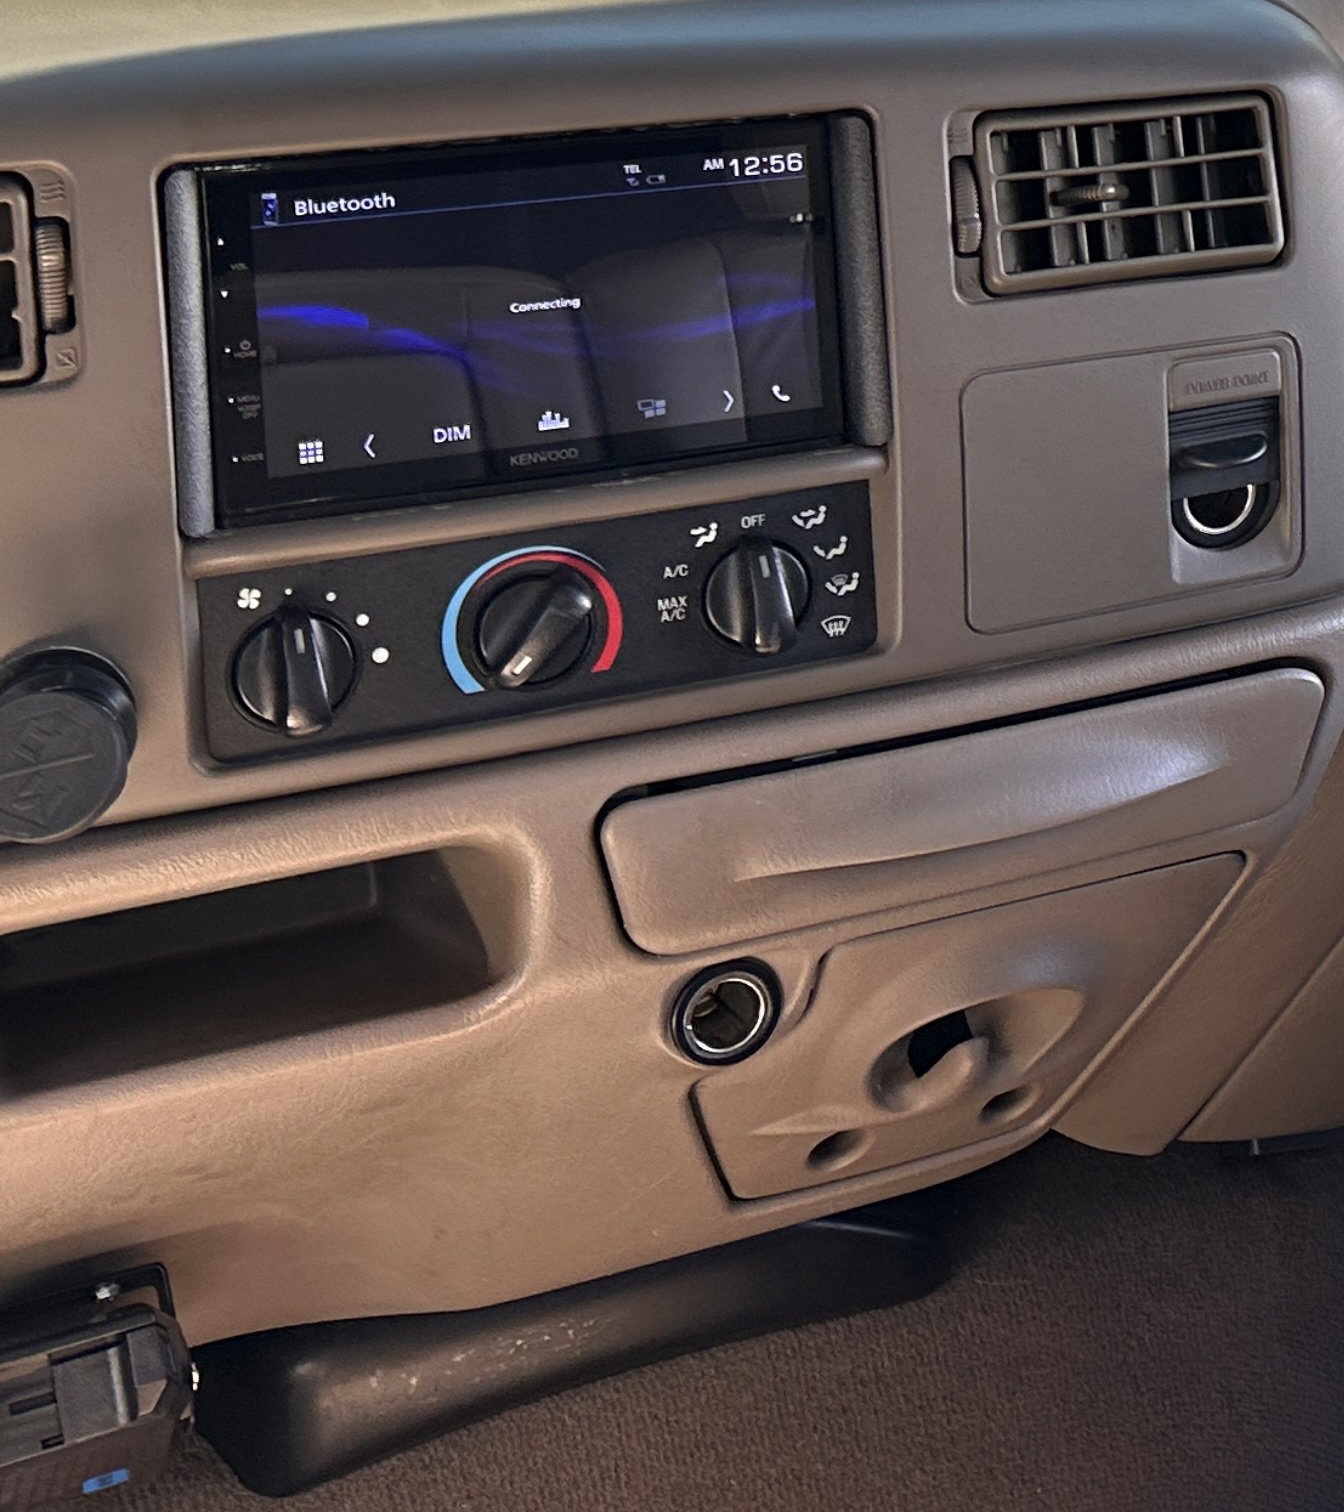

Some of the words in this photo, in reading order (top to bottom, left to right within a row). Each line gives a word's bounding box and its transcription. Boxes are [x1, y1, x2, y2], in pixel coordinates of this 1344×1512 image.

[623, 163, 642, 174] TEL
[703, 159, 724, 171] AM
[728, 152, 804, 178] 12:56
[293, 191, 397, 217] Bluetooth
[509, 296, 582, 315] Connecting
[433, 423, 472, 444] DIM
[509, 446, 579, 467] KENWOOD
[740, 513, 767, 529] OFF
[662, 563, 689, 579] A/C
[656, 596, 688, 612] MAX
[660, 607, 687, 623] A/C
